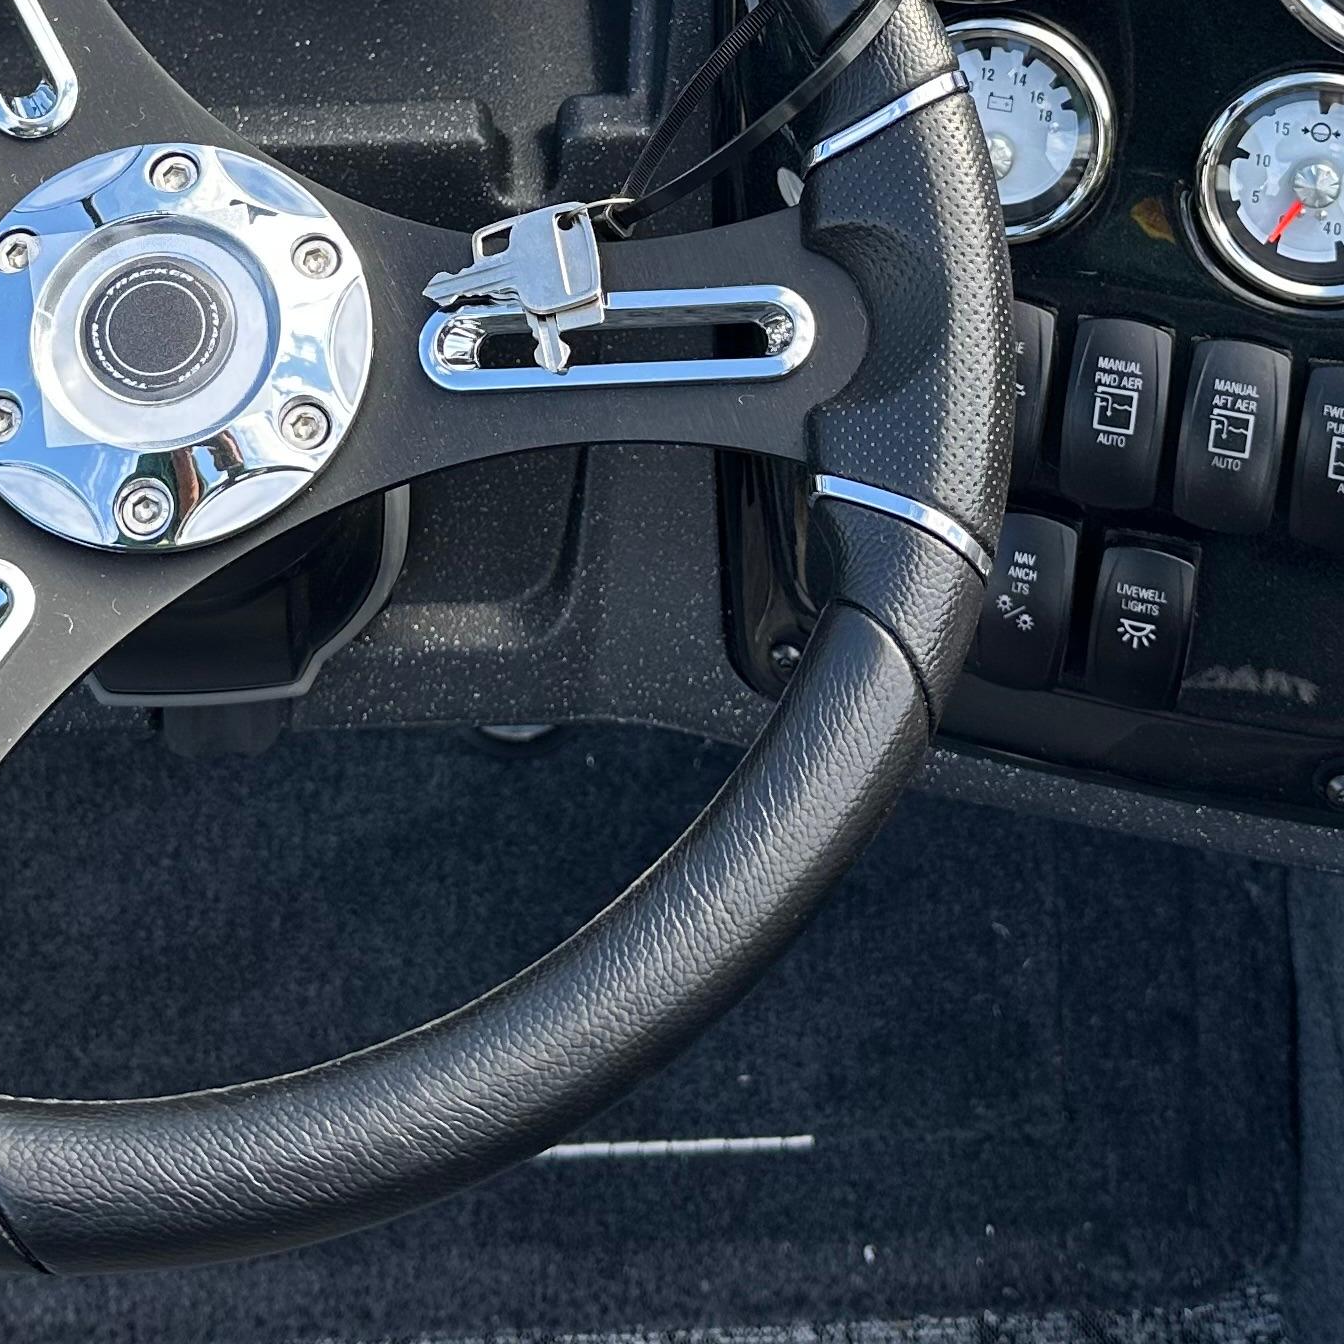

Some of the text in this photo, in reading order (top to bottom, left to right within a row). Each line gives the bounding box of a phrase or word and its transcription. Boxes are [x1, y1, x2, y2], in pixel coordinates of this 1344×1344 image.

[982, 67, 995, 82] 12
[1013, 72, 1027, 87] 14
[1030, 90, 1045, 105] 16
[1039, 109, 1053, 123] 18
[1275, 121, 1290, 136] 15
[1256, 154, 1271, 168] 10
[1252, 190, 1260, 204] 5
[1323, 221, 1342, 236] 40
[107, 268, 195, 296] TRACKER
[1098, 356, 1143, 376] MANUAL
[1095, 372, 1144, 390] FWD AER
[1214, 378, 1260, 399] MANUAL
[1212, 394, 1257, 413] AFT AER
[1096, 433, 1126, 449] AUTO
[1211, 456, 1242, 472] AUTO
[1013, 551, 1036, 566] NAV
[1008, 566, 1038, 583] ANCH
[1011, 581, 1030, 596] LTS
[1117, 583, 1168, 604] LIVEWELL
[1121, 599, 1160, 617] LIGHTS
